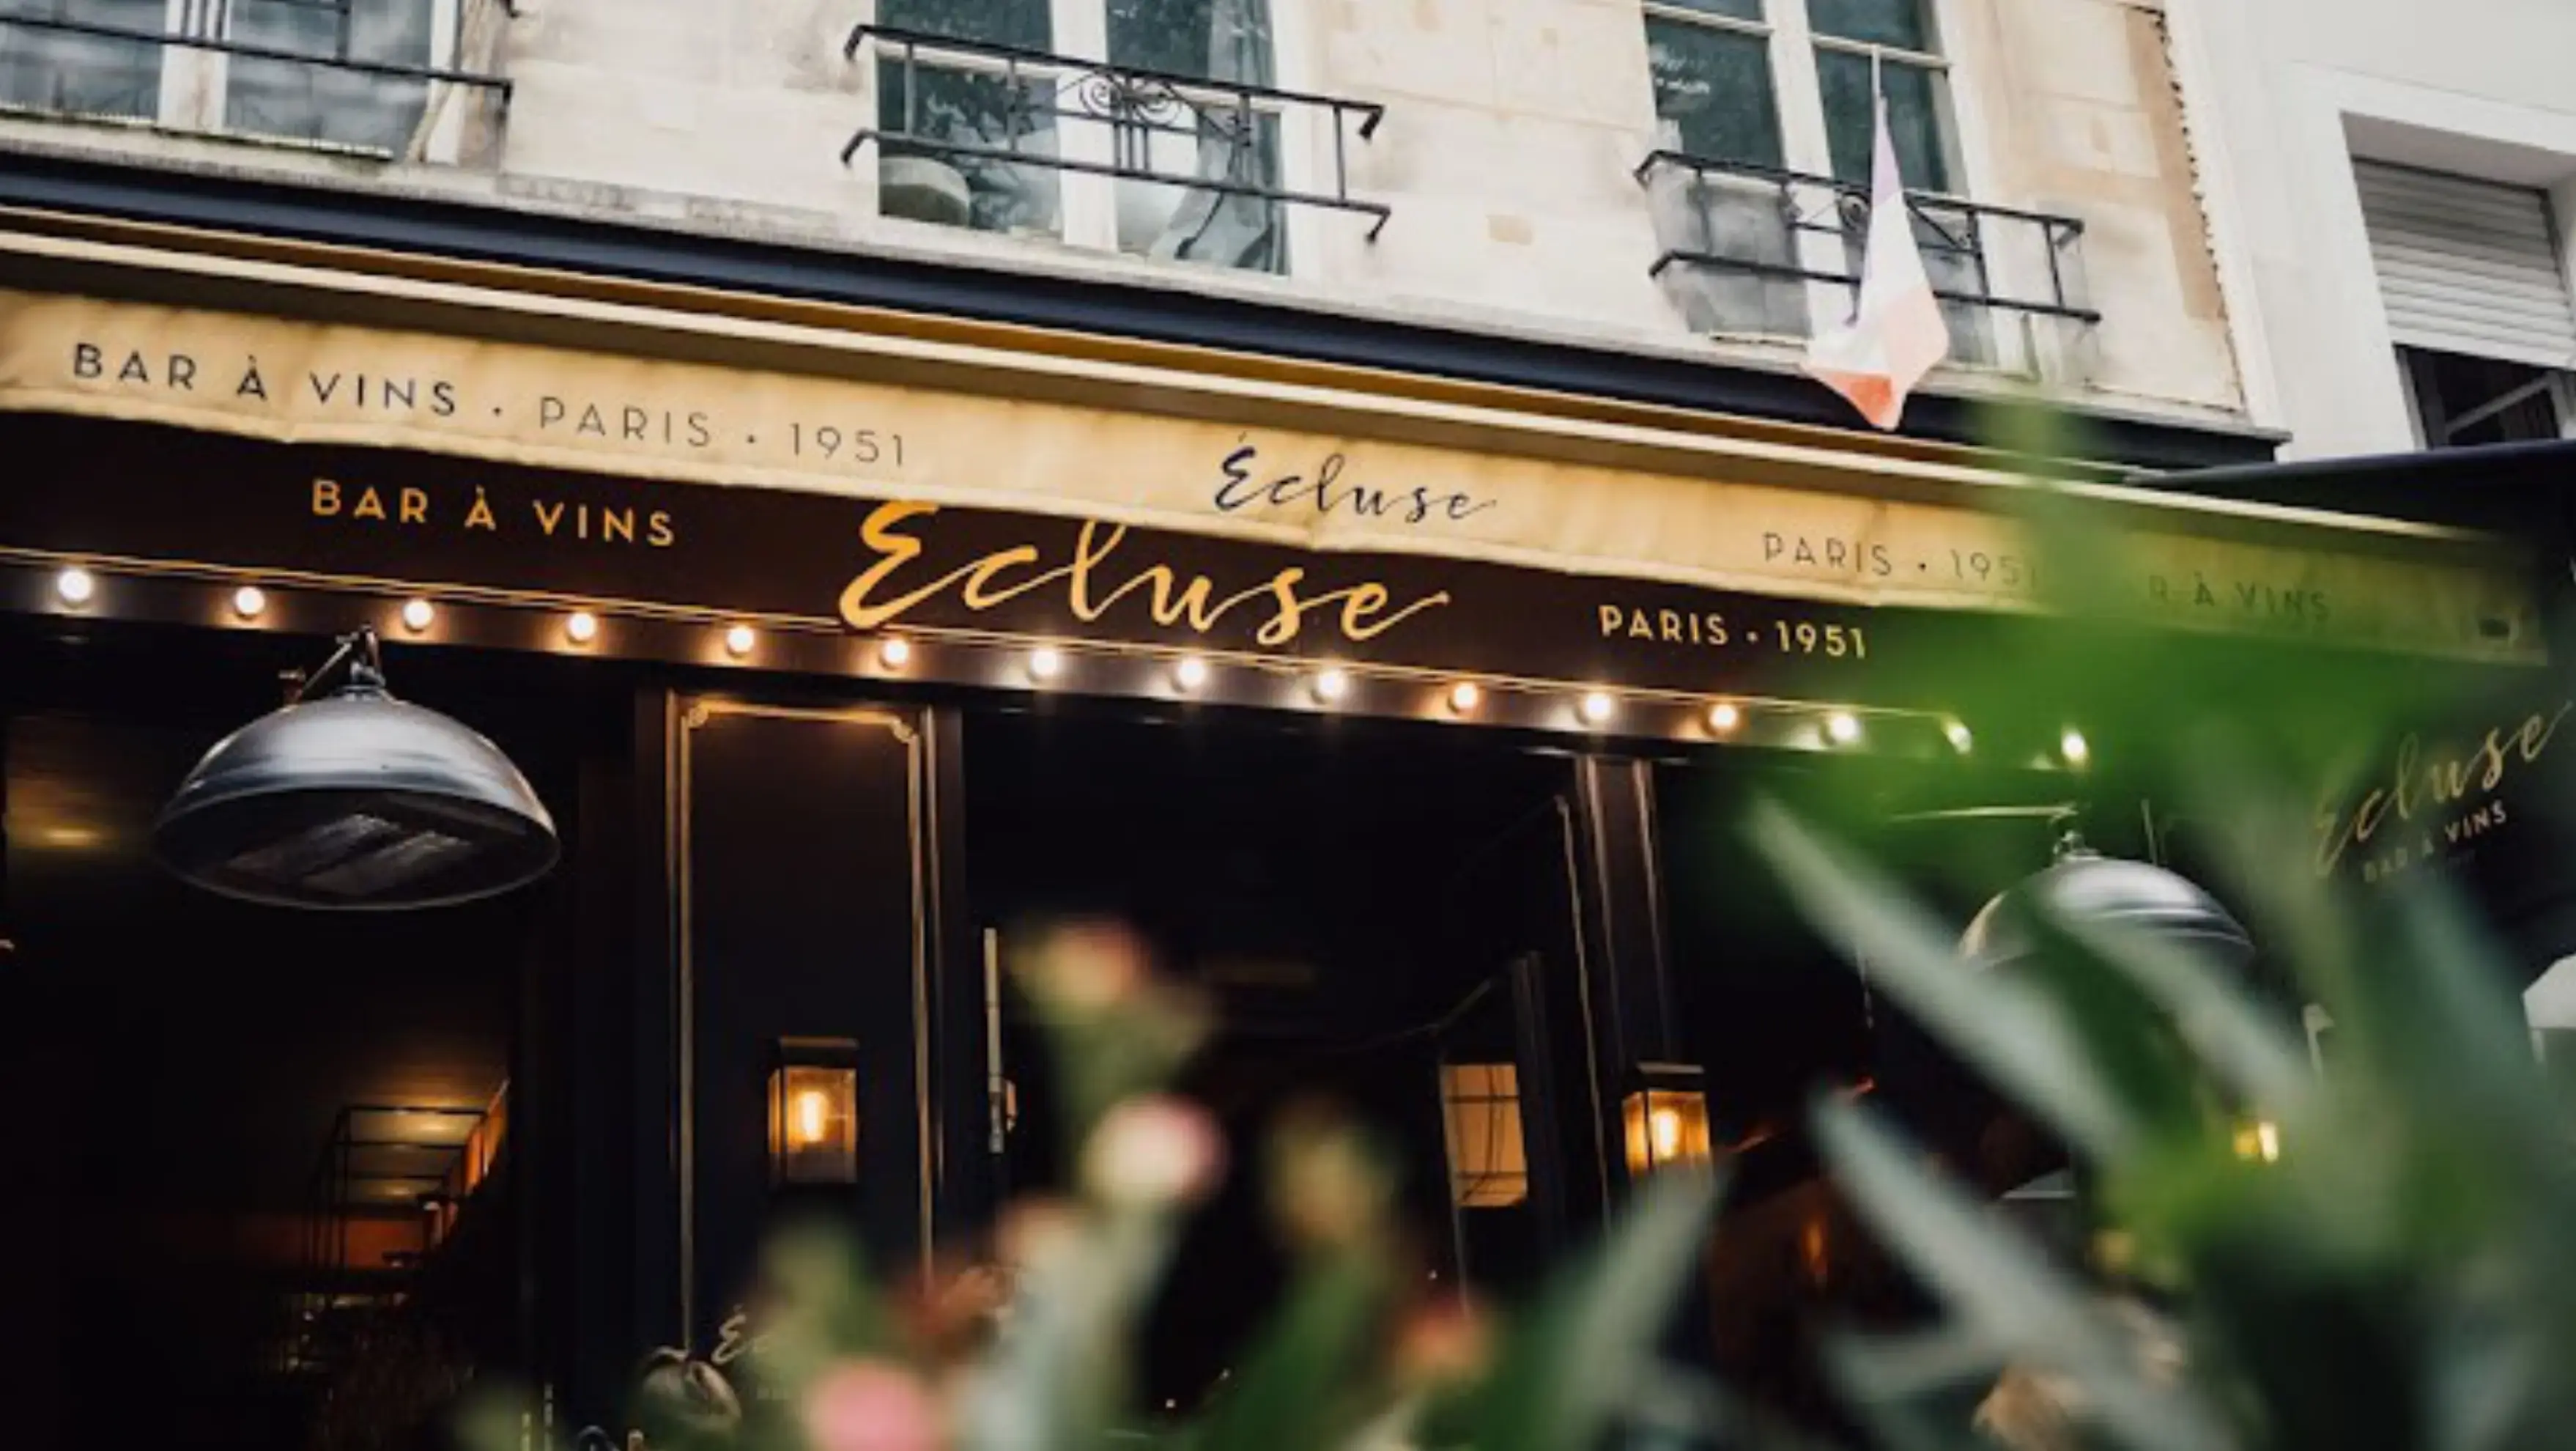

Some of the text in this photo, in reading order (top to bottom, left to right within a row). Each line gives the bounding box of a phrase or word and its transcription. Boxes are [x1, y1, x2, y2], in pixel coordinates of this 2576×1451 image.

[73, 342, 905, 467] BAR À VINS PARIS 1951
[1213, 430, 1498, 524] Écluse
[312, 478, 675, 547] BAR À VINS
[1763, 531, 1893, 577] PARIS
[1598, 605, 1866, 659] PARIS 1951
[2444, 800, 2508, 843] VINS
